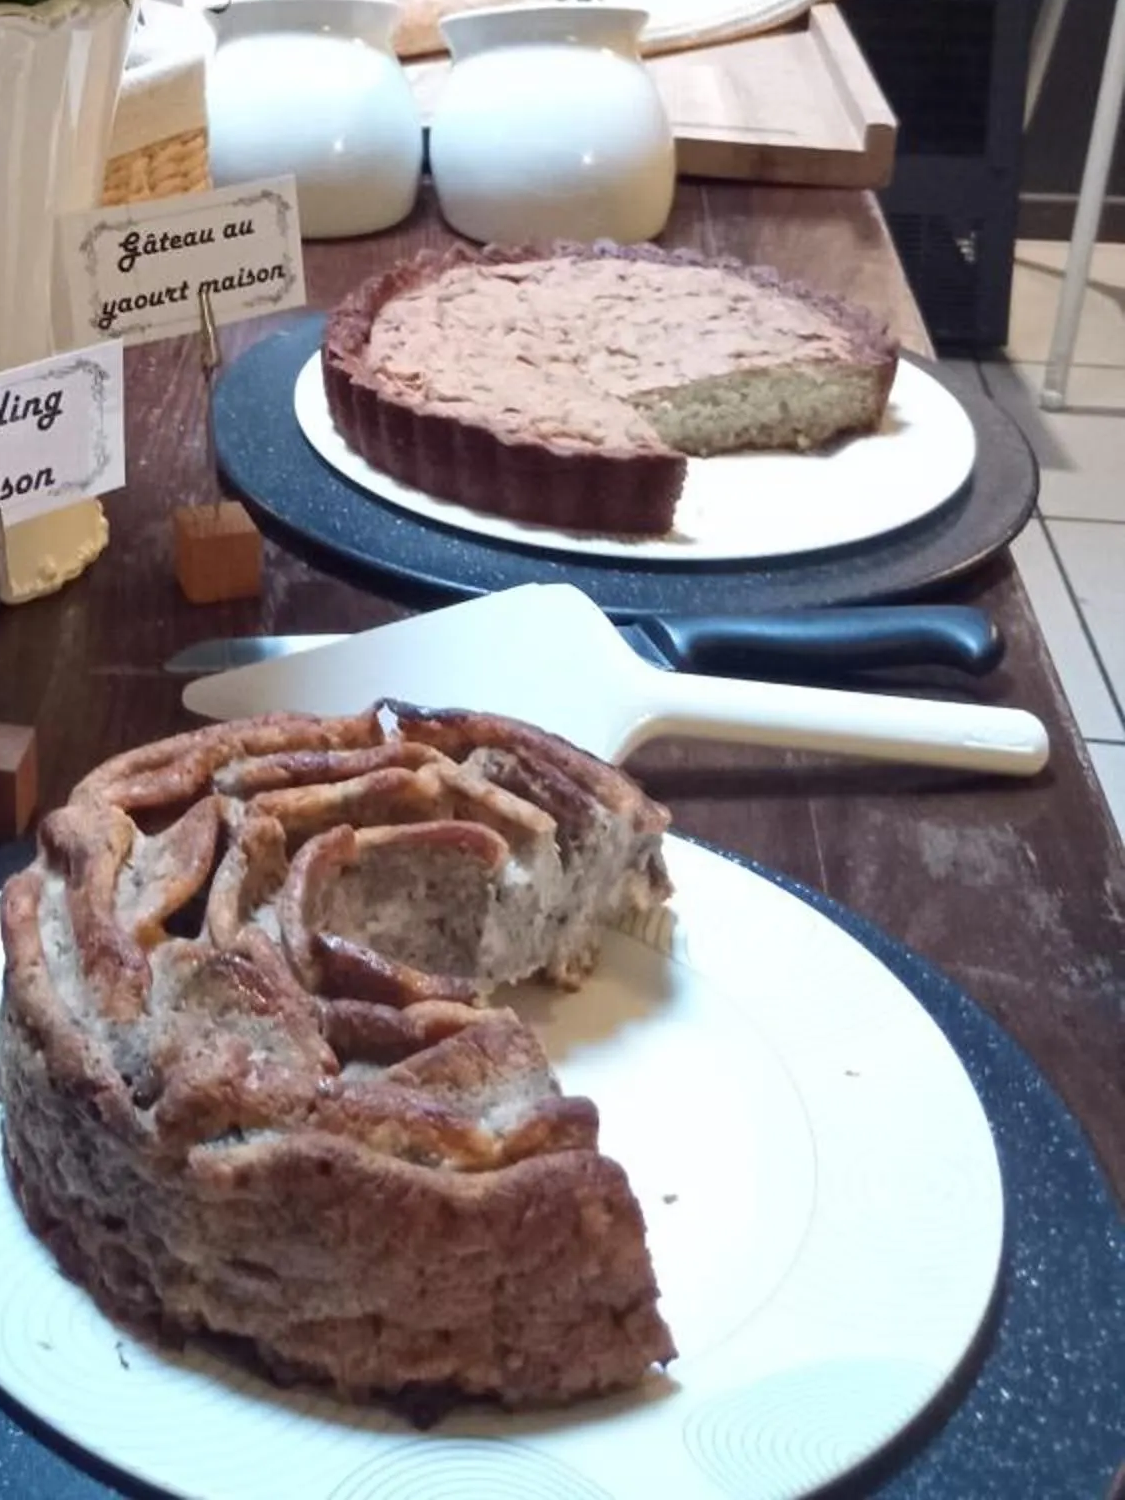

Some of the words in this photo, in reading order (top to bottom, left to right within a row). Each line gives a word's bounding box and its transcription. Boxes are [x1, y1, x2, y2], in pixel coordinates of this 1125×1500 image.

[117, 230, 215, 273] Gâteau
[222, 217, 255, 240] au
[98, 280, 190, 331] yaourt
[199, 262, 286, 296] maison
